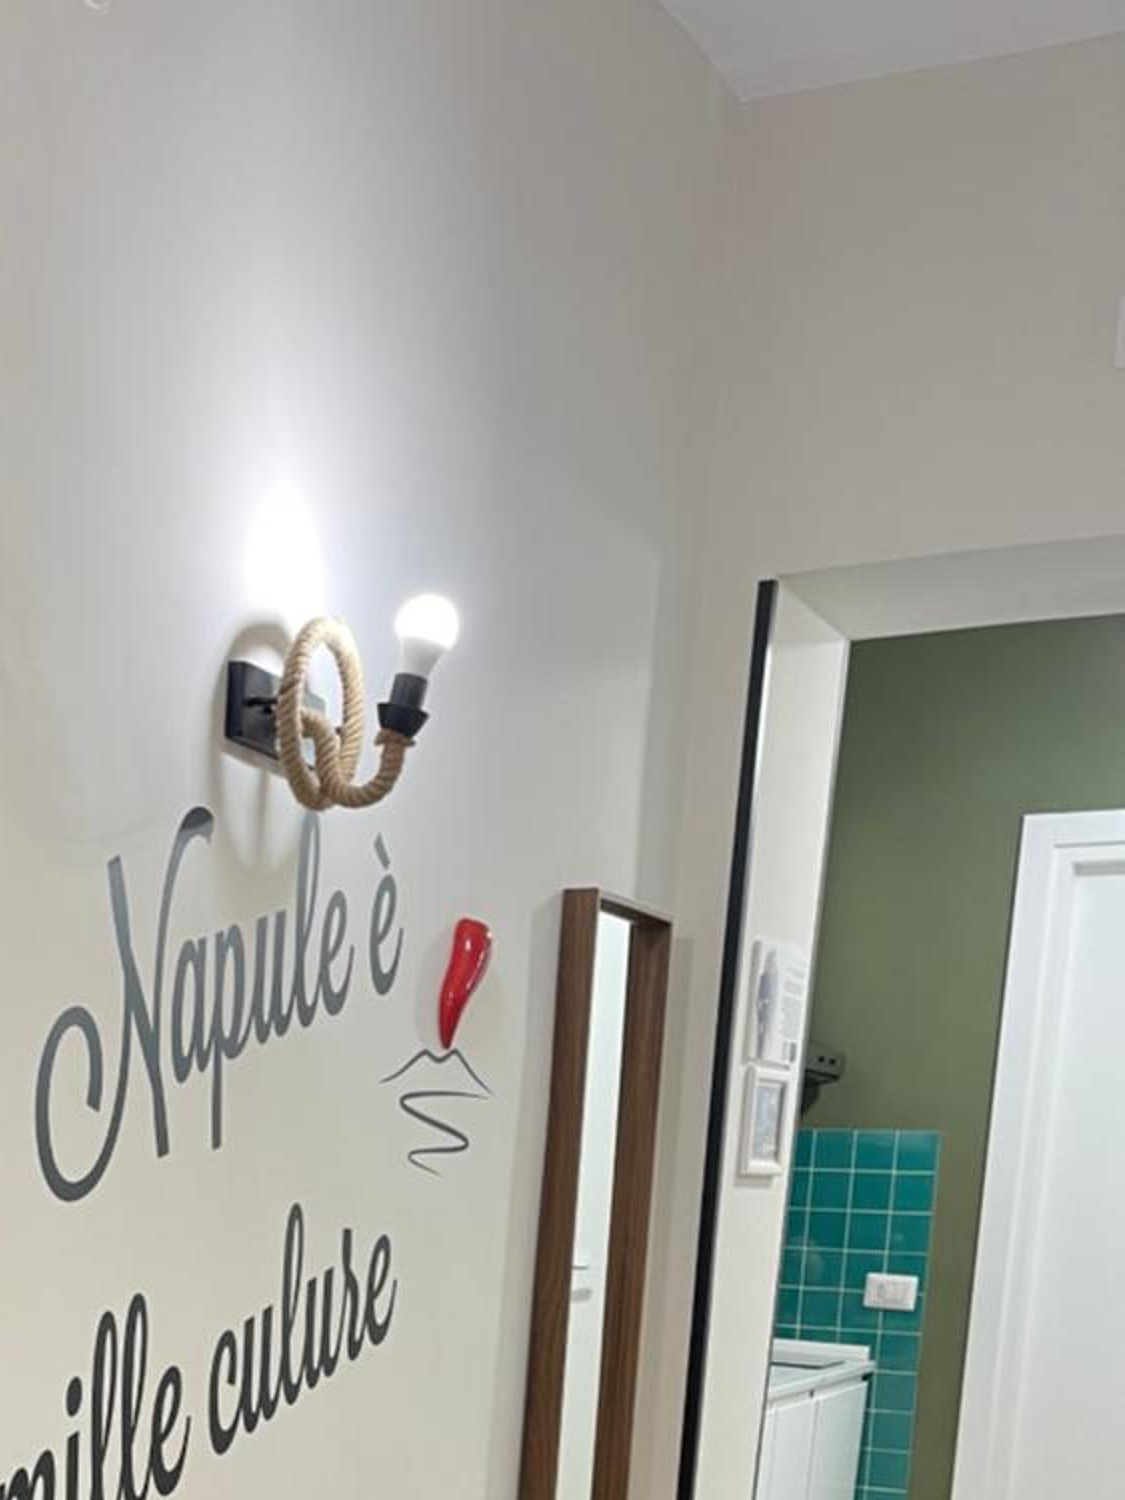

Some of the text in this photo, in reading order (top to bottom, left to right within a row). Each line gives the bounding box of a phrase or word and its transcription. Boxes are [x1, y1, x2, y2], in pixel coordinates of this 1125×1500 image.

[35, 805, 403, 1202] Napule è
[208, 1203, 397, 1455] culure
